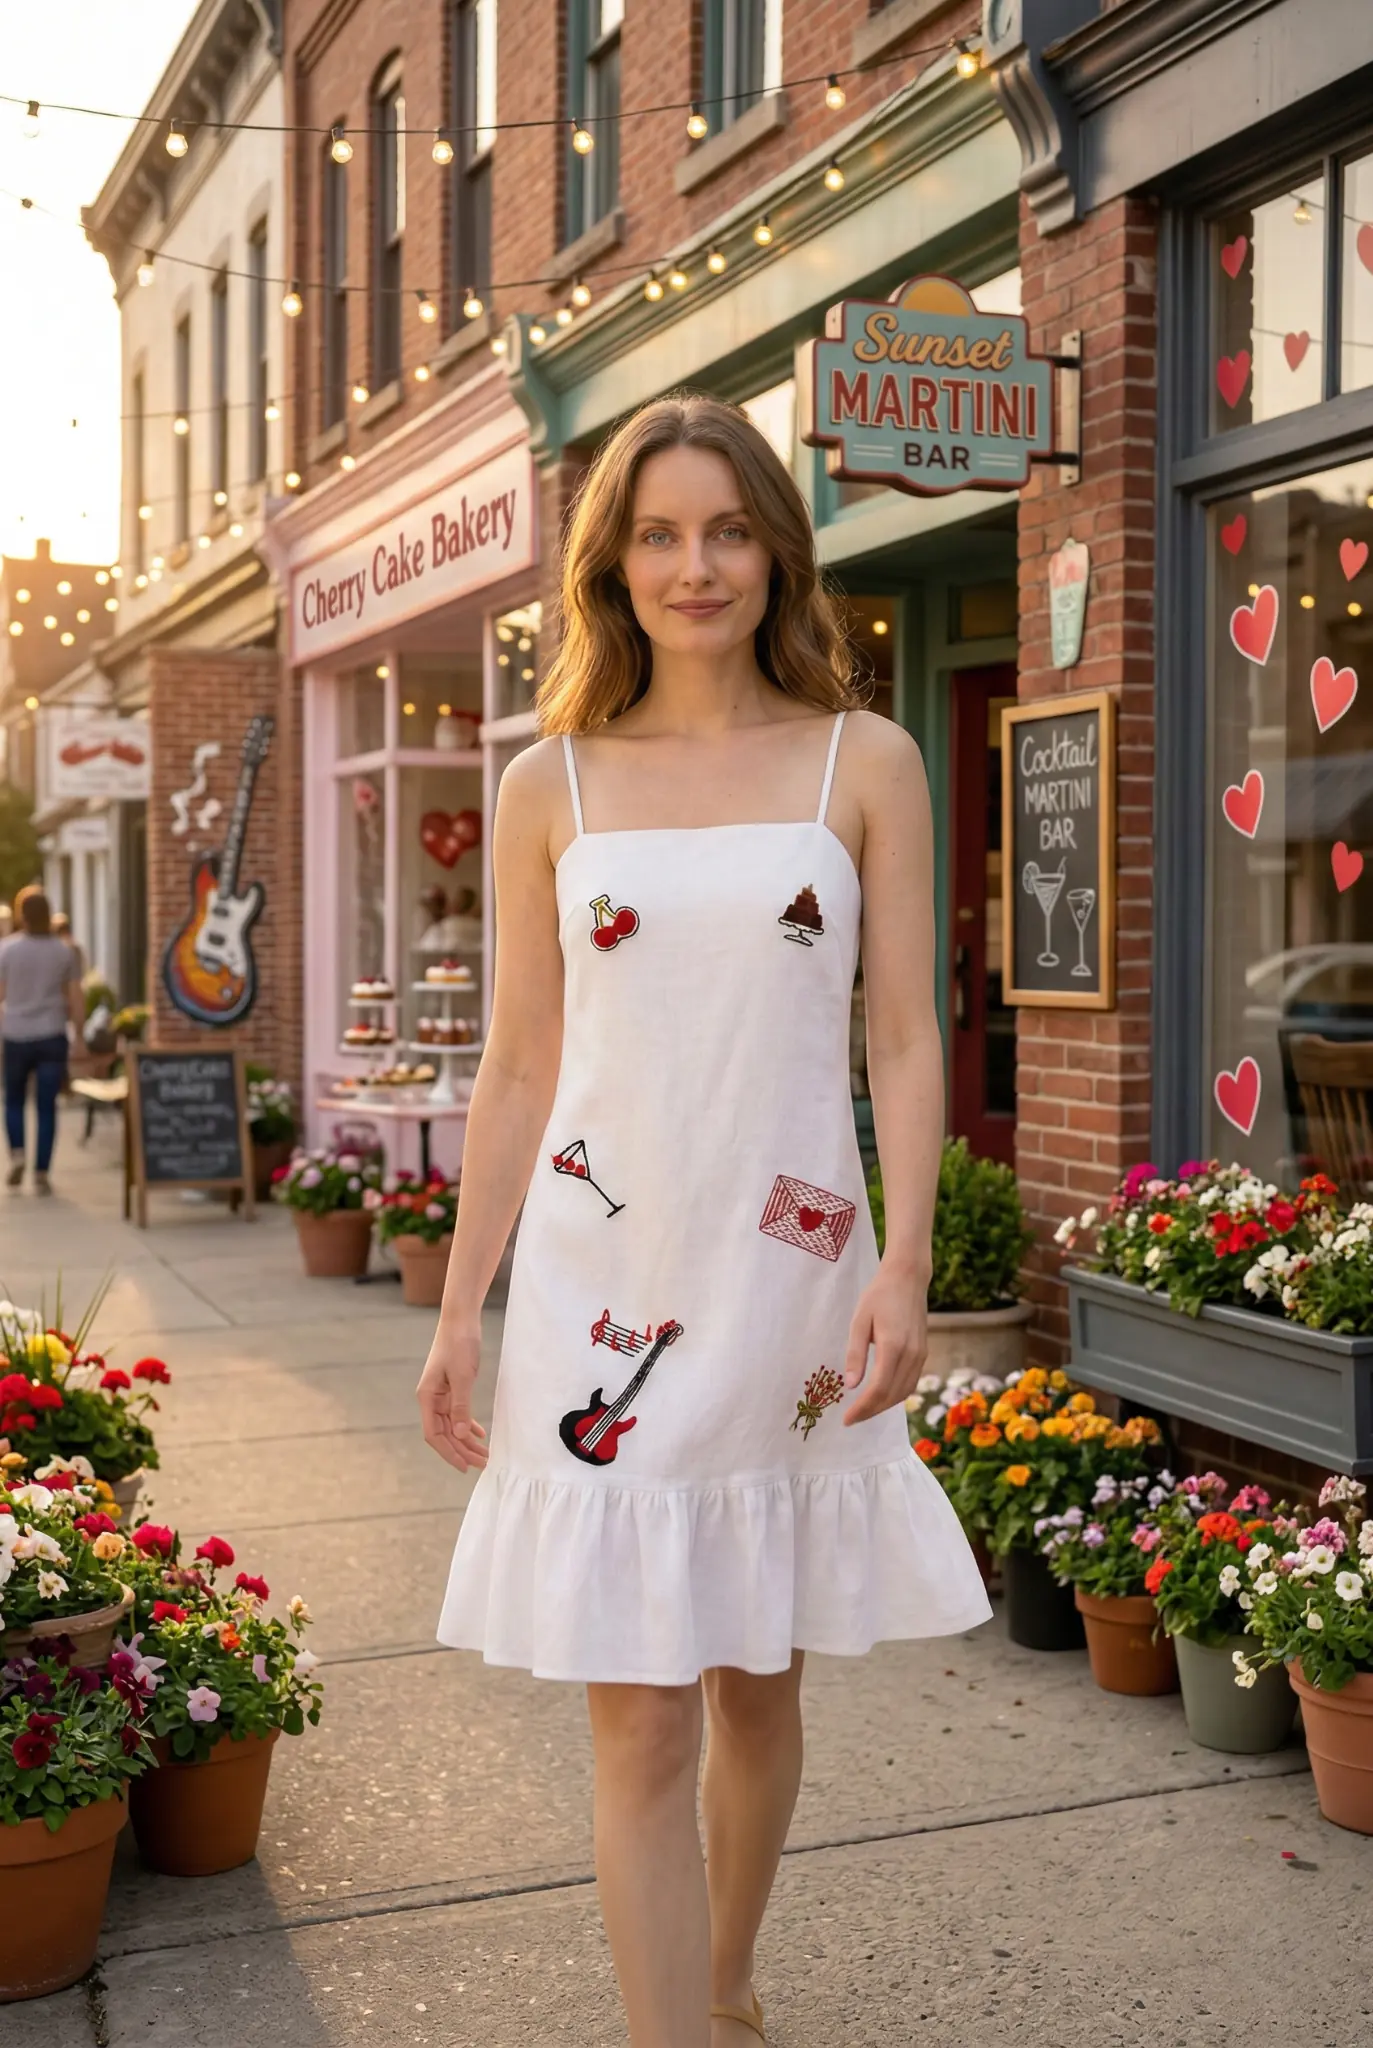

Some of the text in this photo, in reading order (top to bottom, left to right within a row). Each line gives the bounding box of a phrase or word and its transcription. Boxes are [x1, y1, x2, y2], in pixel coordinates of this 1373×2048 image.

[853, 311, 1013, 371] Sunset
[830, 367, 1037, 439] MARTINI
[903, 442, 971, 471] BAR
[302, 488, 516, 629] Cherry Cake Bakery
[1020, 723, 1097, 777] Cocktail
[1024, 776, 1092, 815] MARTINI
[1039, 817, 1078, 851] BAR
